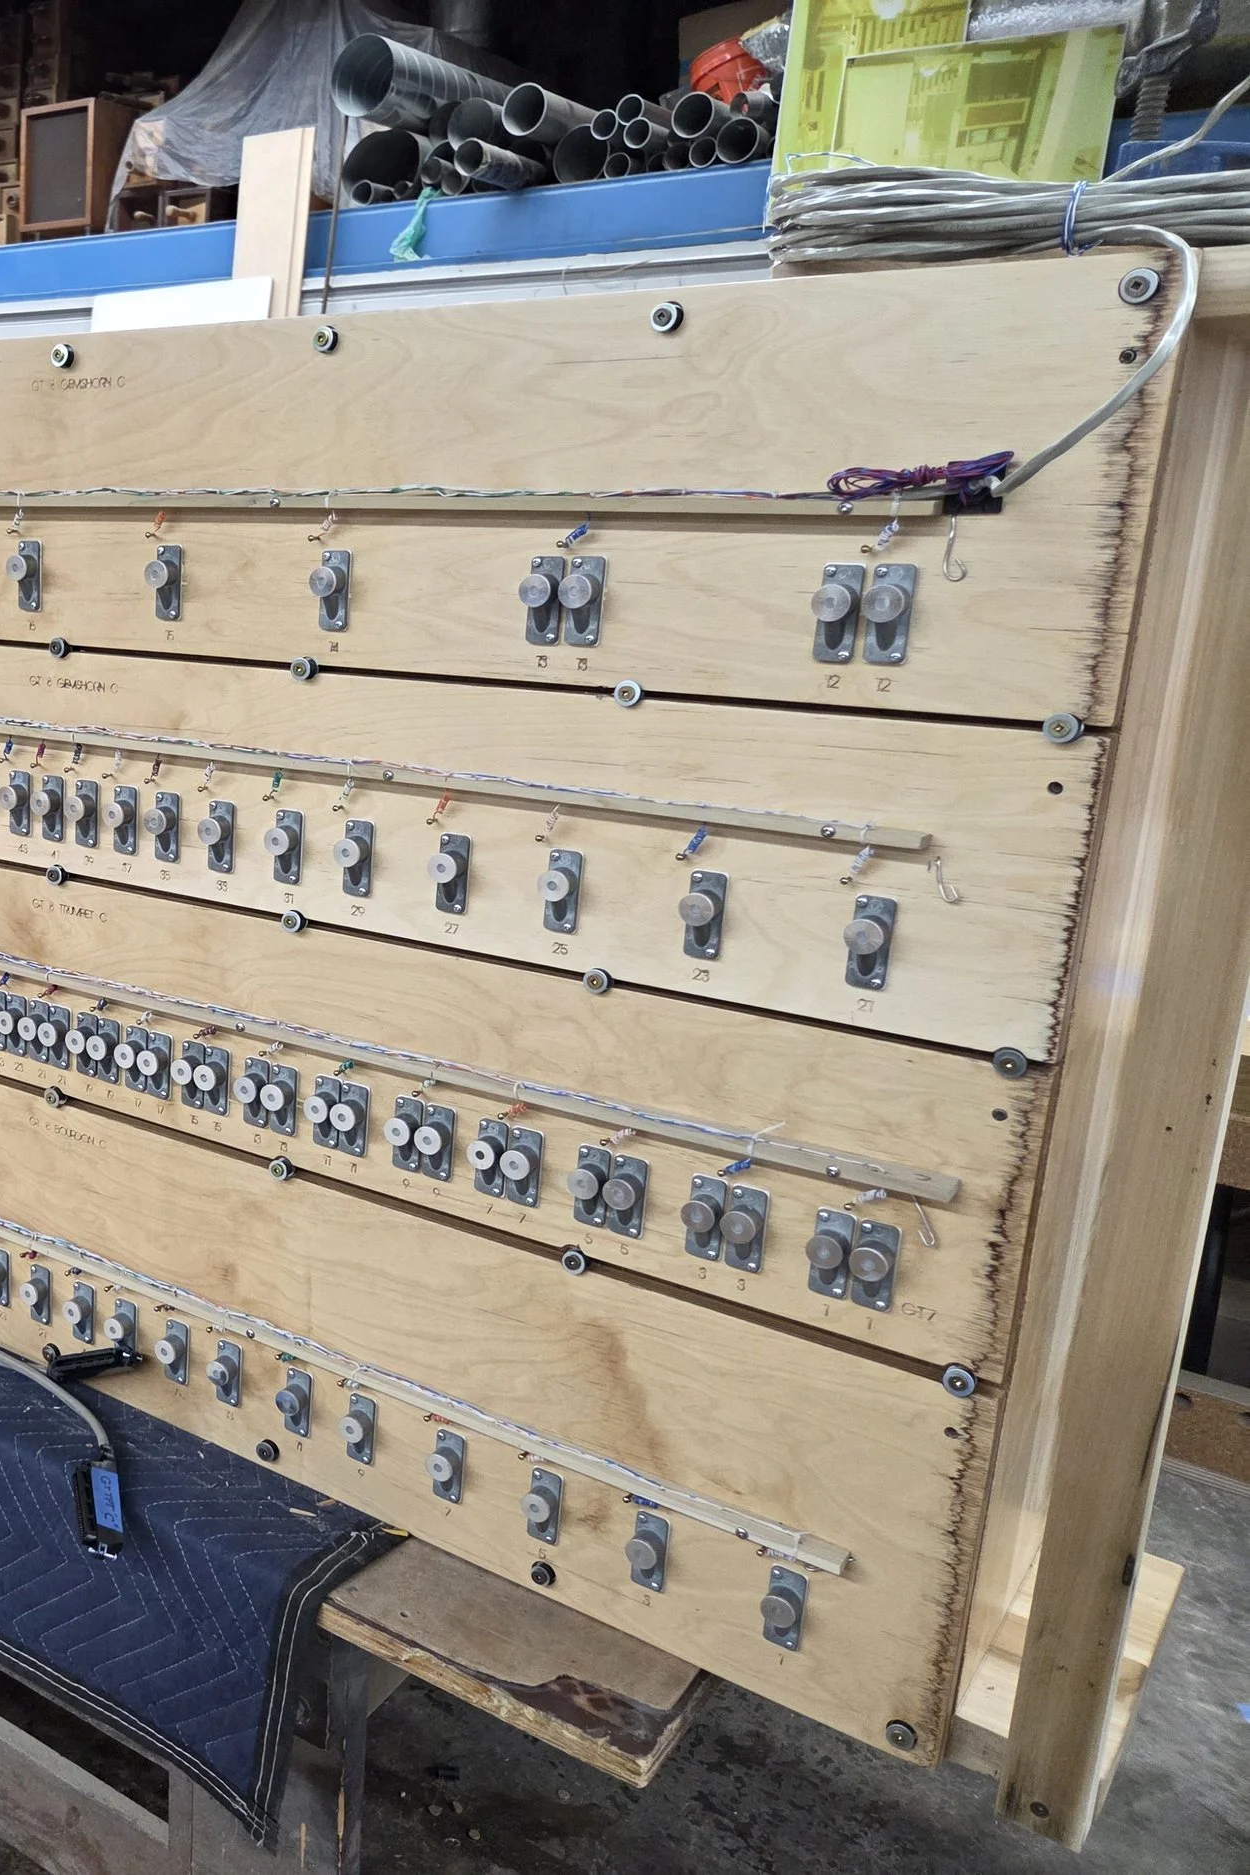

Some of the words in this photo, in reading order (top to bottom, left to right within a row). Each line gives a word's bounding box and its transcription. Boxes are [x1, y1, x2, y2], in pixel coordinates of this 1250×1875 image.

[535, 654, 548, 669] 13
[575, 657, 588, 672] 13
[824, 673, 841, 690] 12
[874, 677, 892, 693] 12
[216, 879, 229, 892] 33
[350, 904, 366, 918] 29
[444, 921, 460, 935] 27
[551, 941, 569, 956] 25
[691, 967, 710, 983] 23
[583, 1232, 593, 1245] 5
[697, 1266, 707, 1280] 3
[736, 1278, 746, 1292] 3
[900, 1302, 938, 1321] GT7
[537, 1548, 547, 1560] 5
